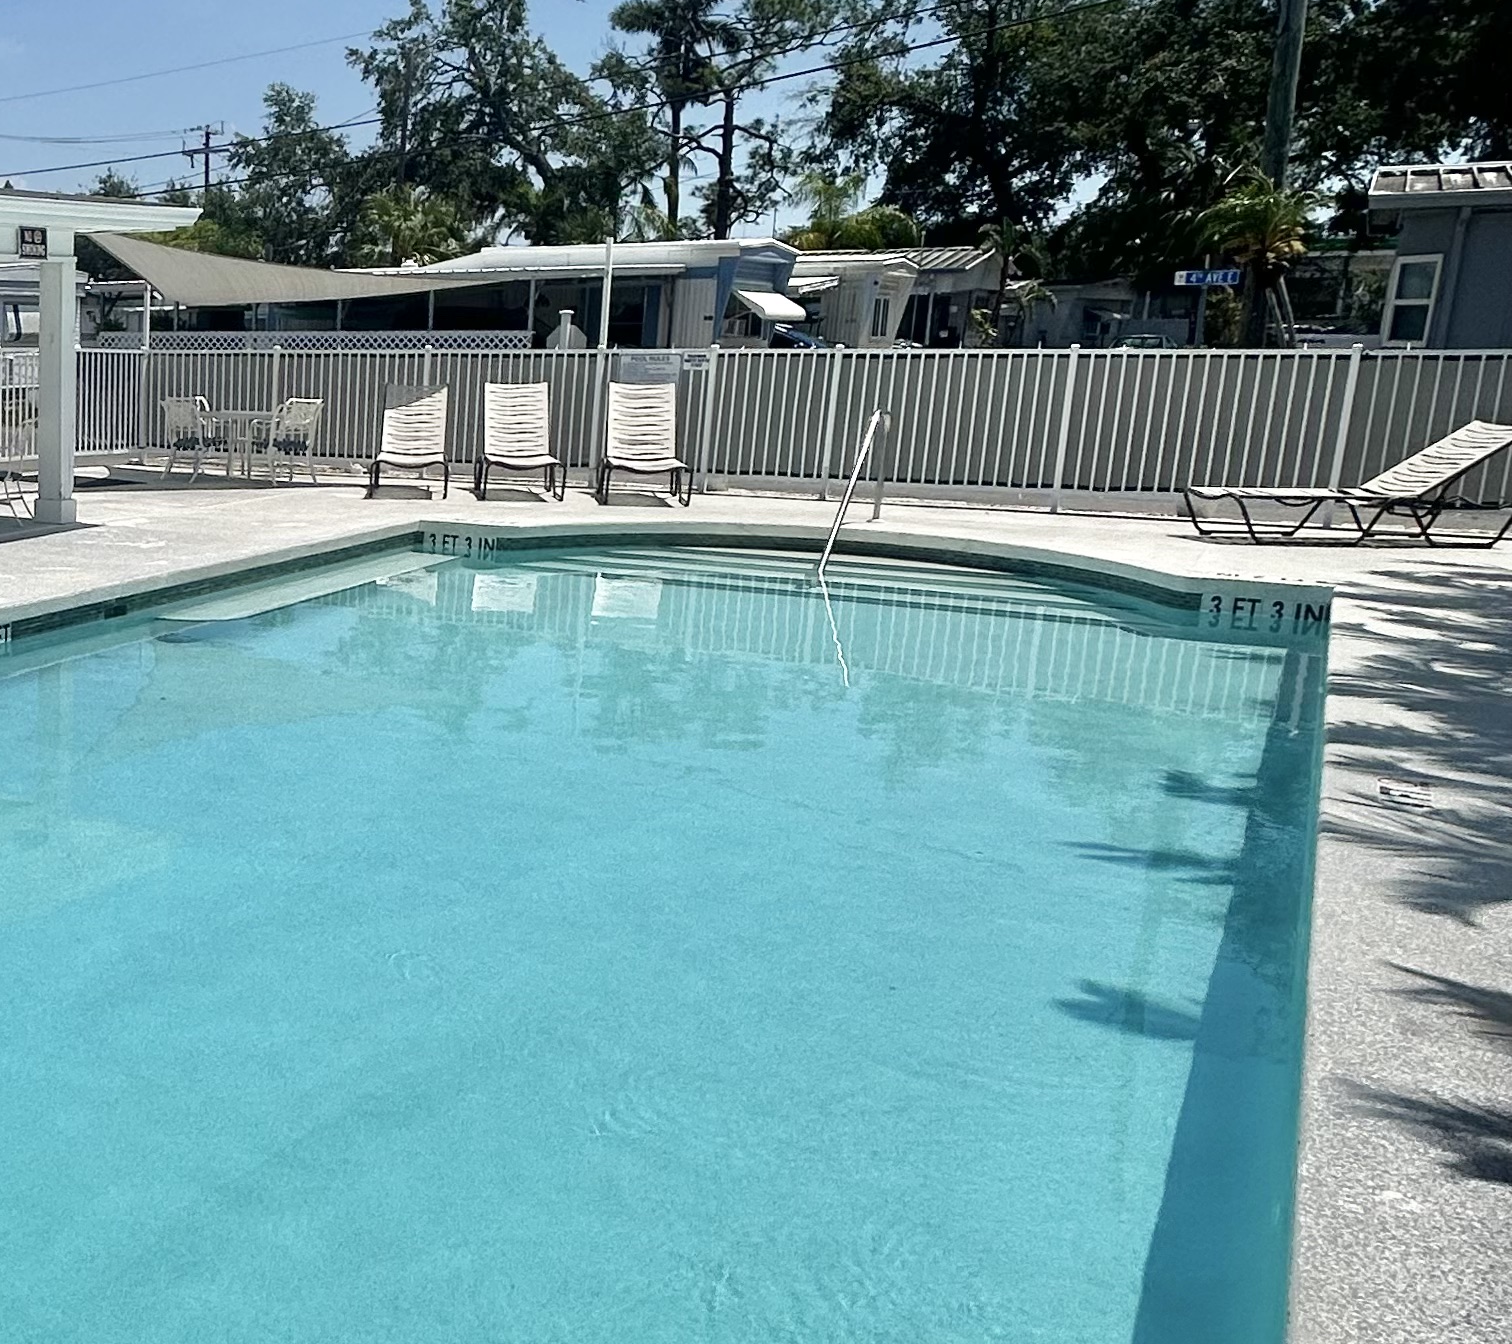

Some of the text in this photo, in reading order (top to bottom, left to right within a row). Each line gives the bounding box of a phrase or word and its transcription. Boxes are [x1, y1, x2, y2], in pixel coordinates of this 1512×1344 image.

[1205, 272, 1225, 283] AVE
[442, 534, 459, 551] FT
[478, 537, 495, 551] IN
[1209, 595, 1222, 613] 3
[1232, 597, 1262, 617] FT
[1271, 600, 1285, 618] 3
